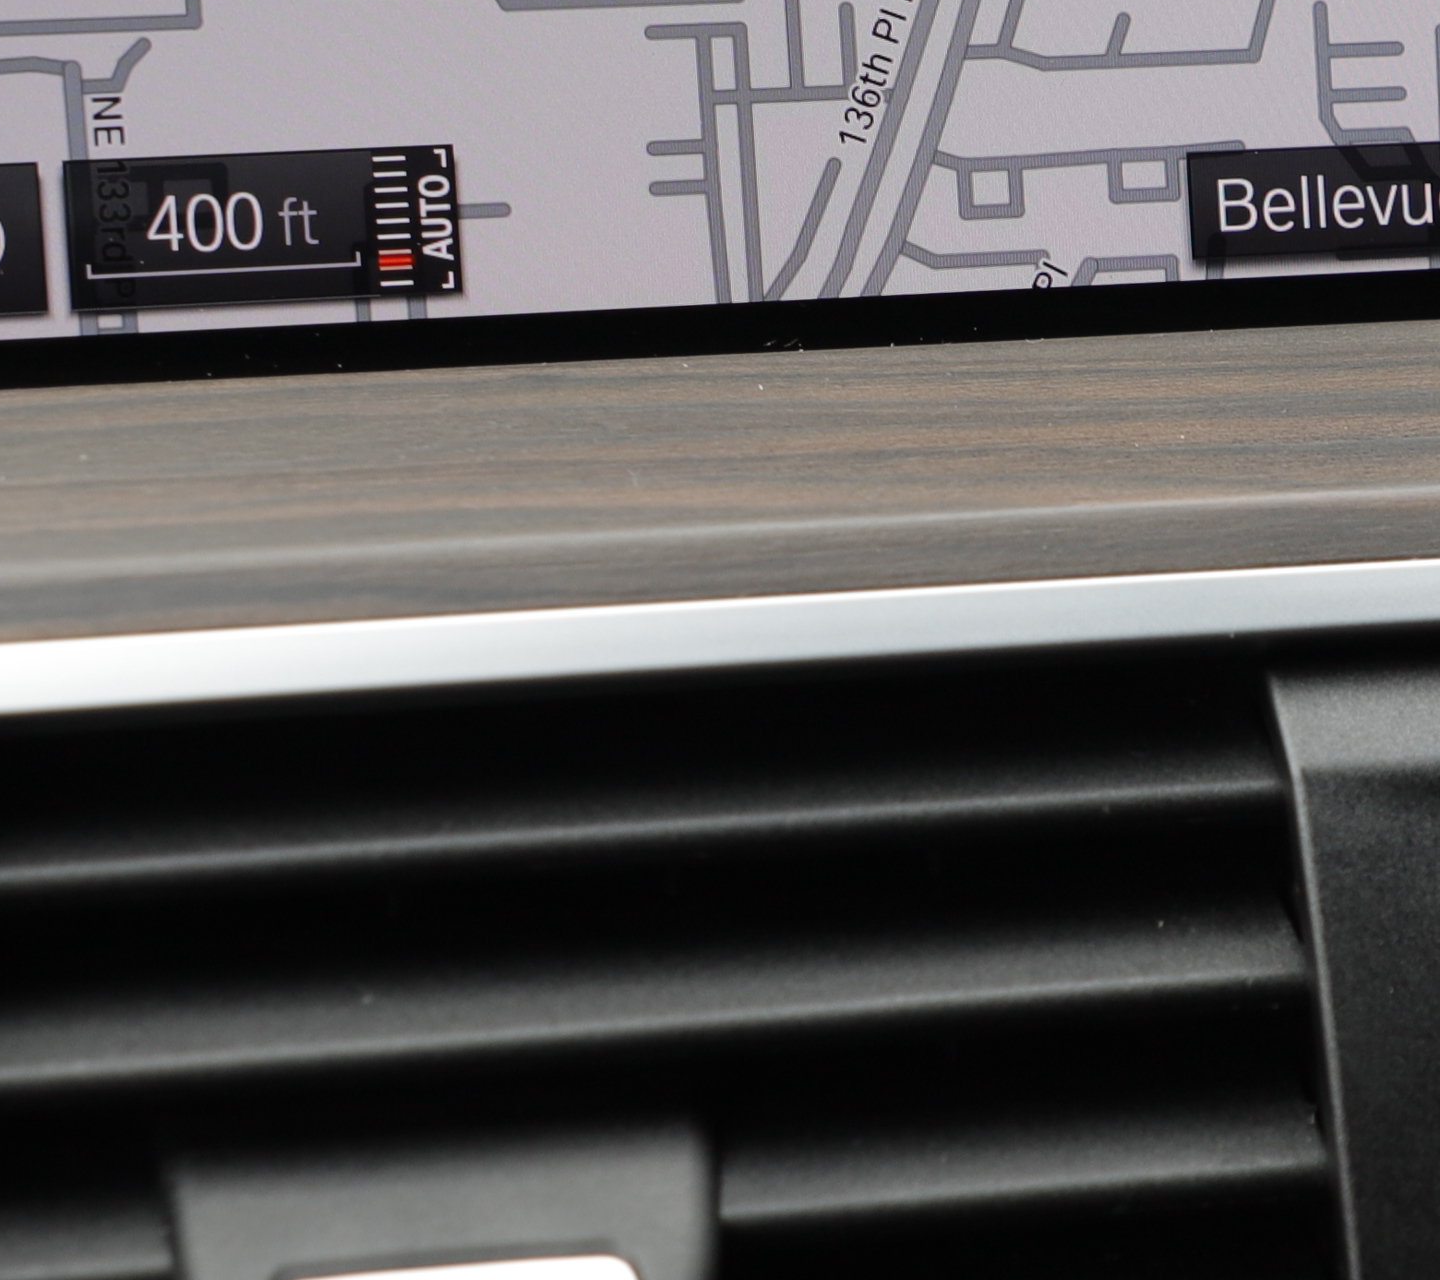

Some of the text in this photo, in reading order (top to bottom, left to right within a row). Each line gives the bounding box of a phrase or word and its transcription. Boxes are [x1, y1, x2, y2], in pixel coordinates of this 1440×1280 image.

[90, 95, 126, 147] NE
[838, 52, 894, 145] 136th
[146, 191, 321, 254] 400 ft
[416, 173, 456, 262] AUTO
